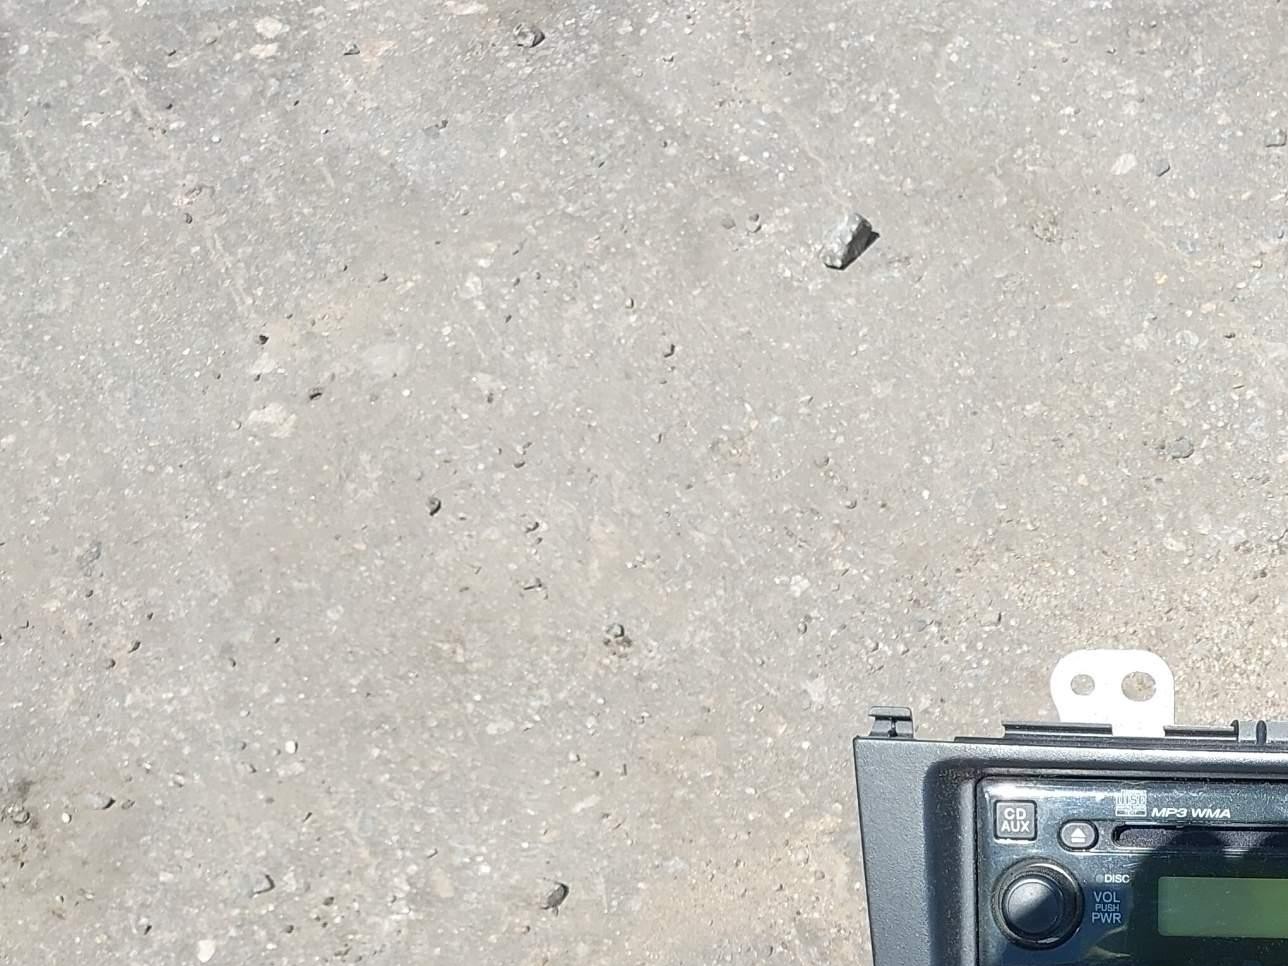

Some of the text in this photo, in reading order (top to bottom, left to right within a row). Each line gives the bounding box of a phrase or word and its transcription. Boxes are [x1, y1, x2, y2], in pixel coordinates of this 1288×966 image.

[1004, 807, 1027, 820] CD
[1151, 807, 1188, 818] MP3
[1191, 808, 1231, 819] WMA
[1000, 820, 1030, 833] AUX
[1104, 874, 1130, 884] DISC
[1093, 891, 1121, 903] VOL
[1095, 903, 1120, 912] PUSH
[1091, 912, 1122, 924] PWR
